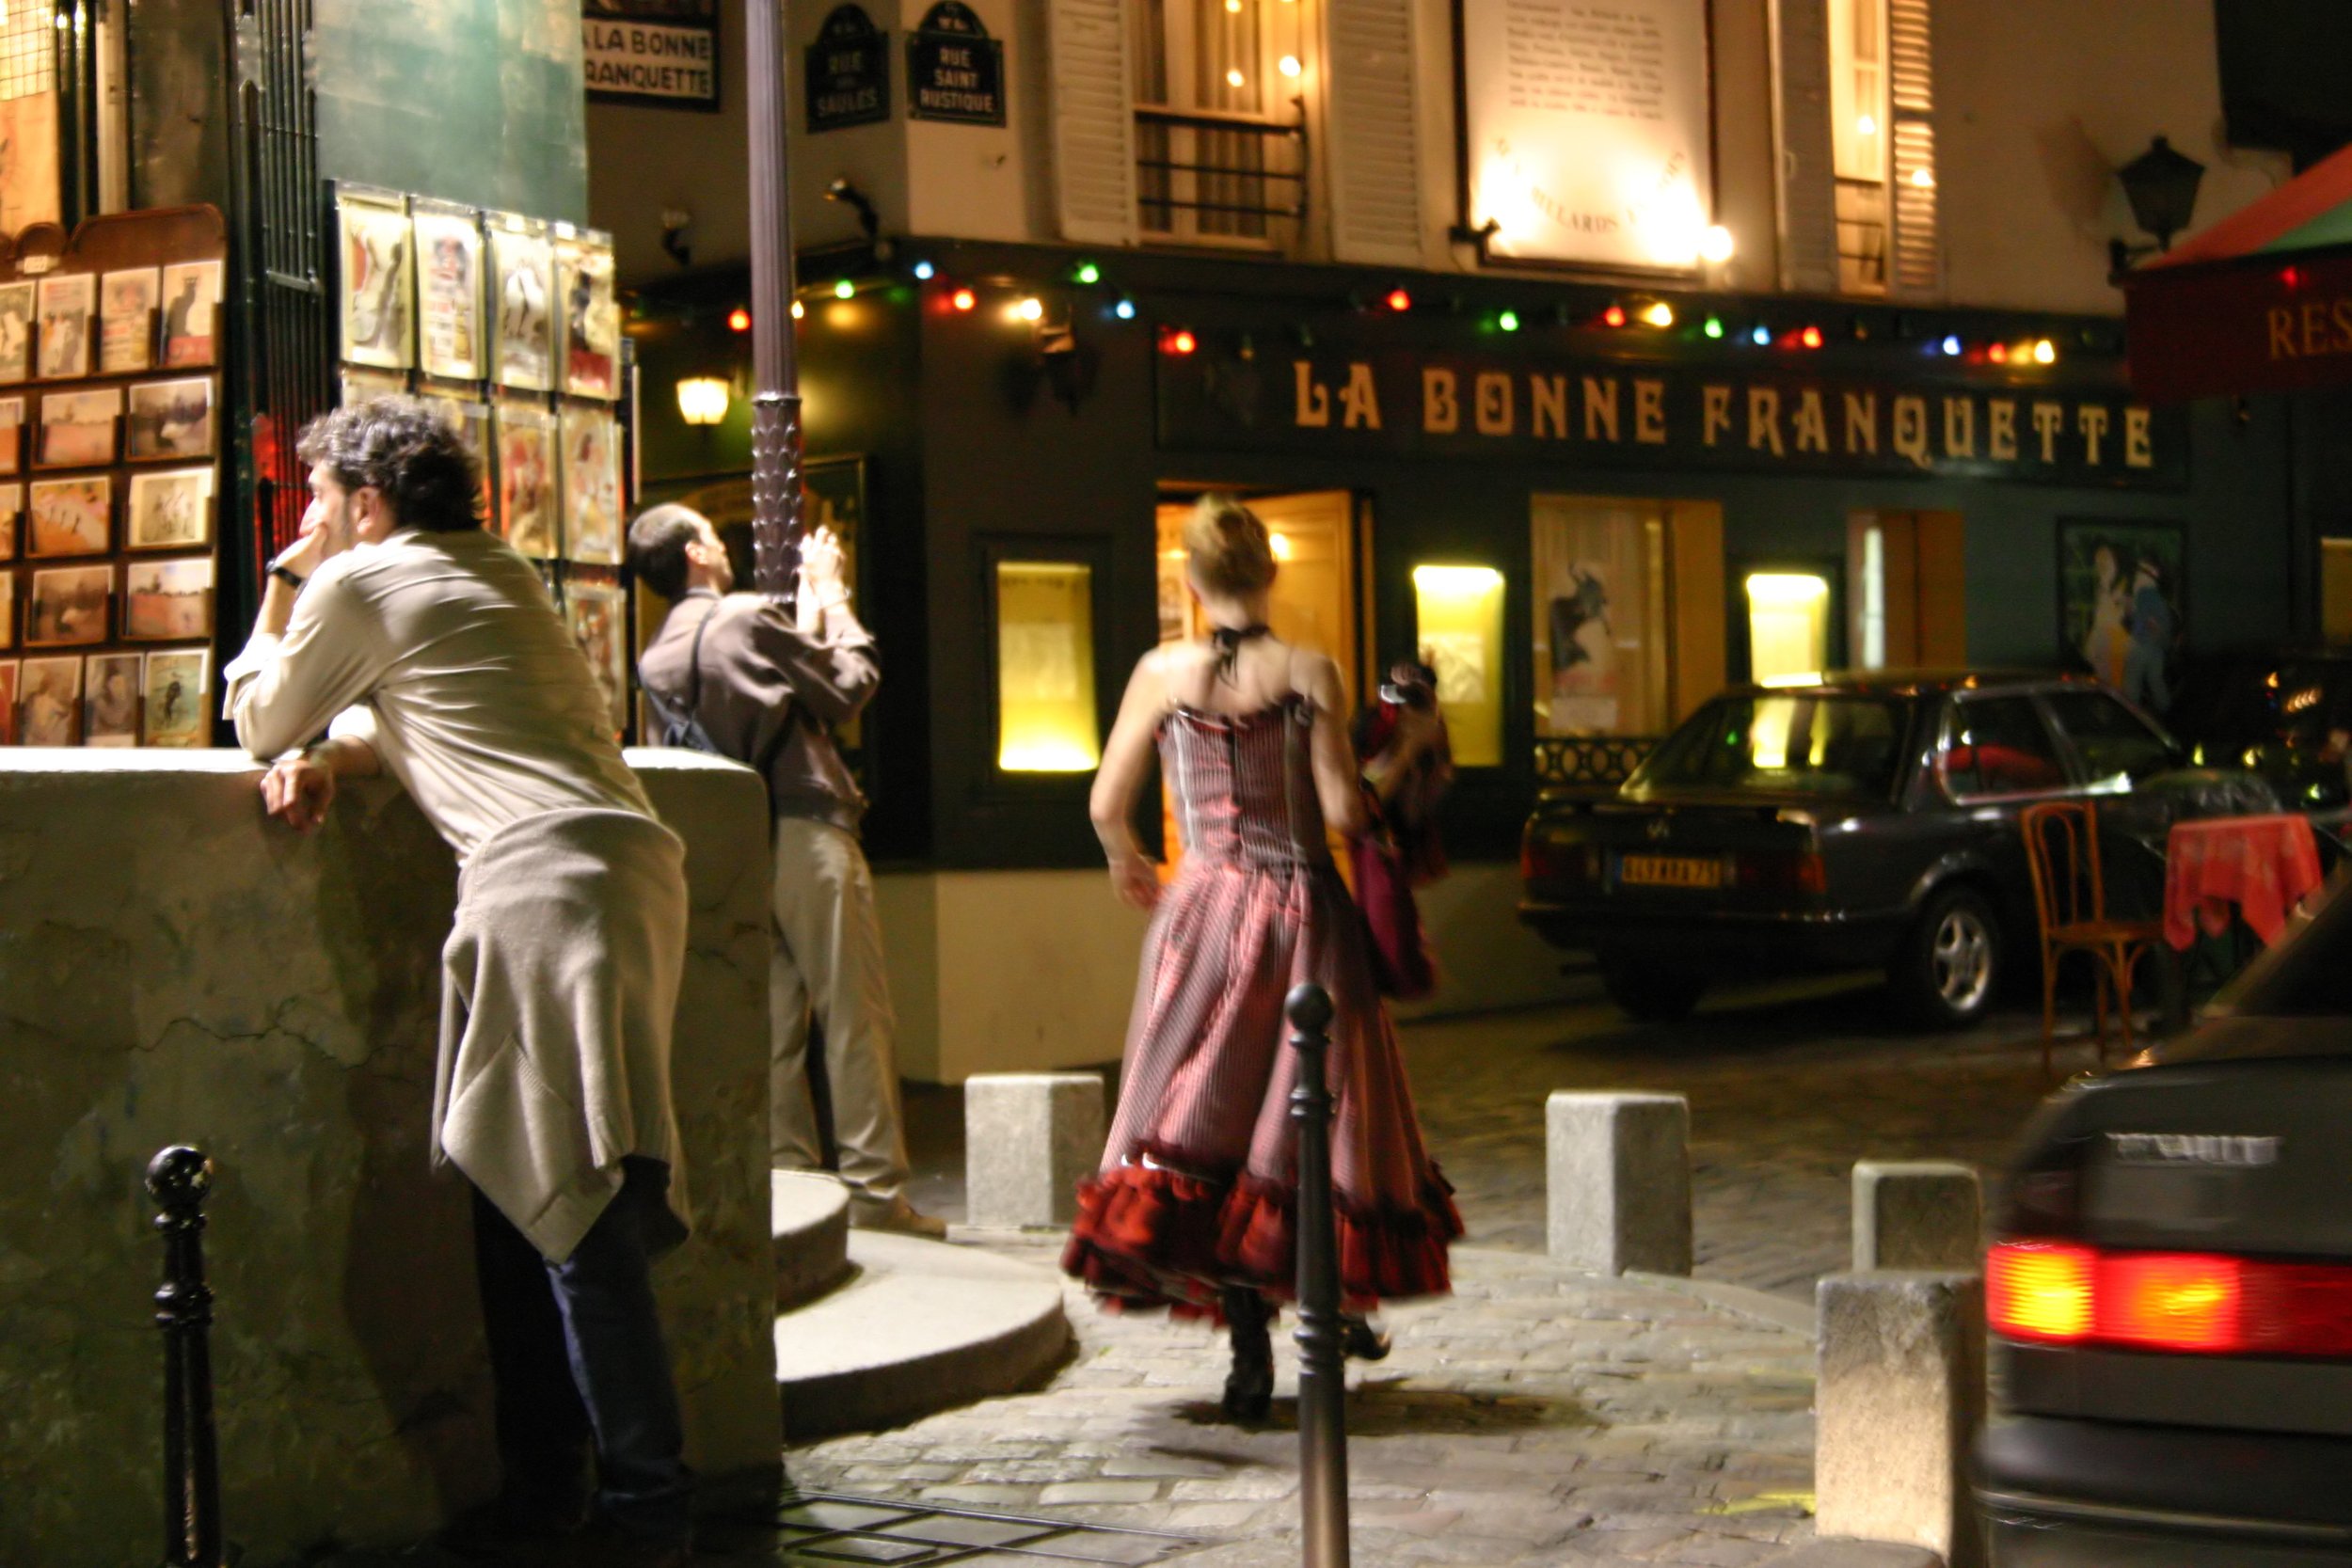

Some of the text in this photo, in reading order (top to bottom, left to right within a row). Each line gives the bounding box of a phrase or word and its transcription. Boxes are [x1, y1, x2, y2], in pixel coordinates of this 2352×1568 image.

[594, 25, 625, 52] LA
[630, 30, 710, 61] BONNE
[940, 47, 972, 70] RUE
[934, 69, 978, 91] SAINT
[920, 88, 995, 115] RUSTIQUE
[1294, 360, 2153, 469] LA BONNE FRANQUETTE
